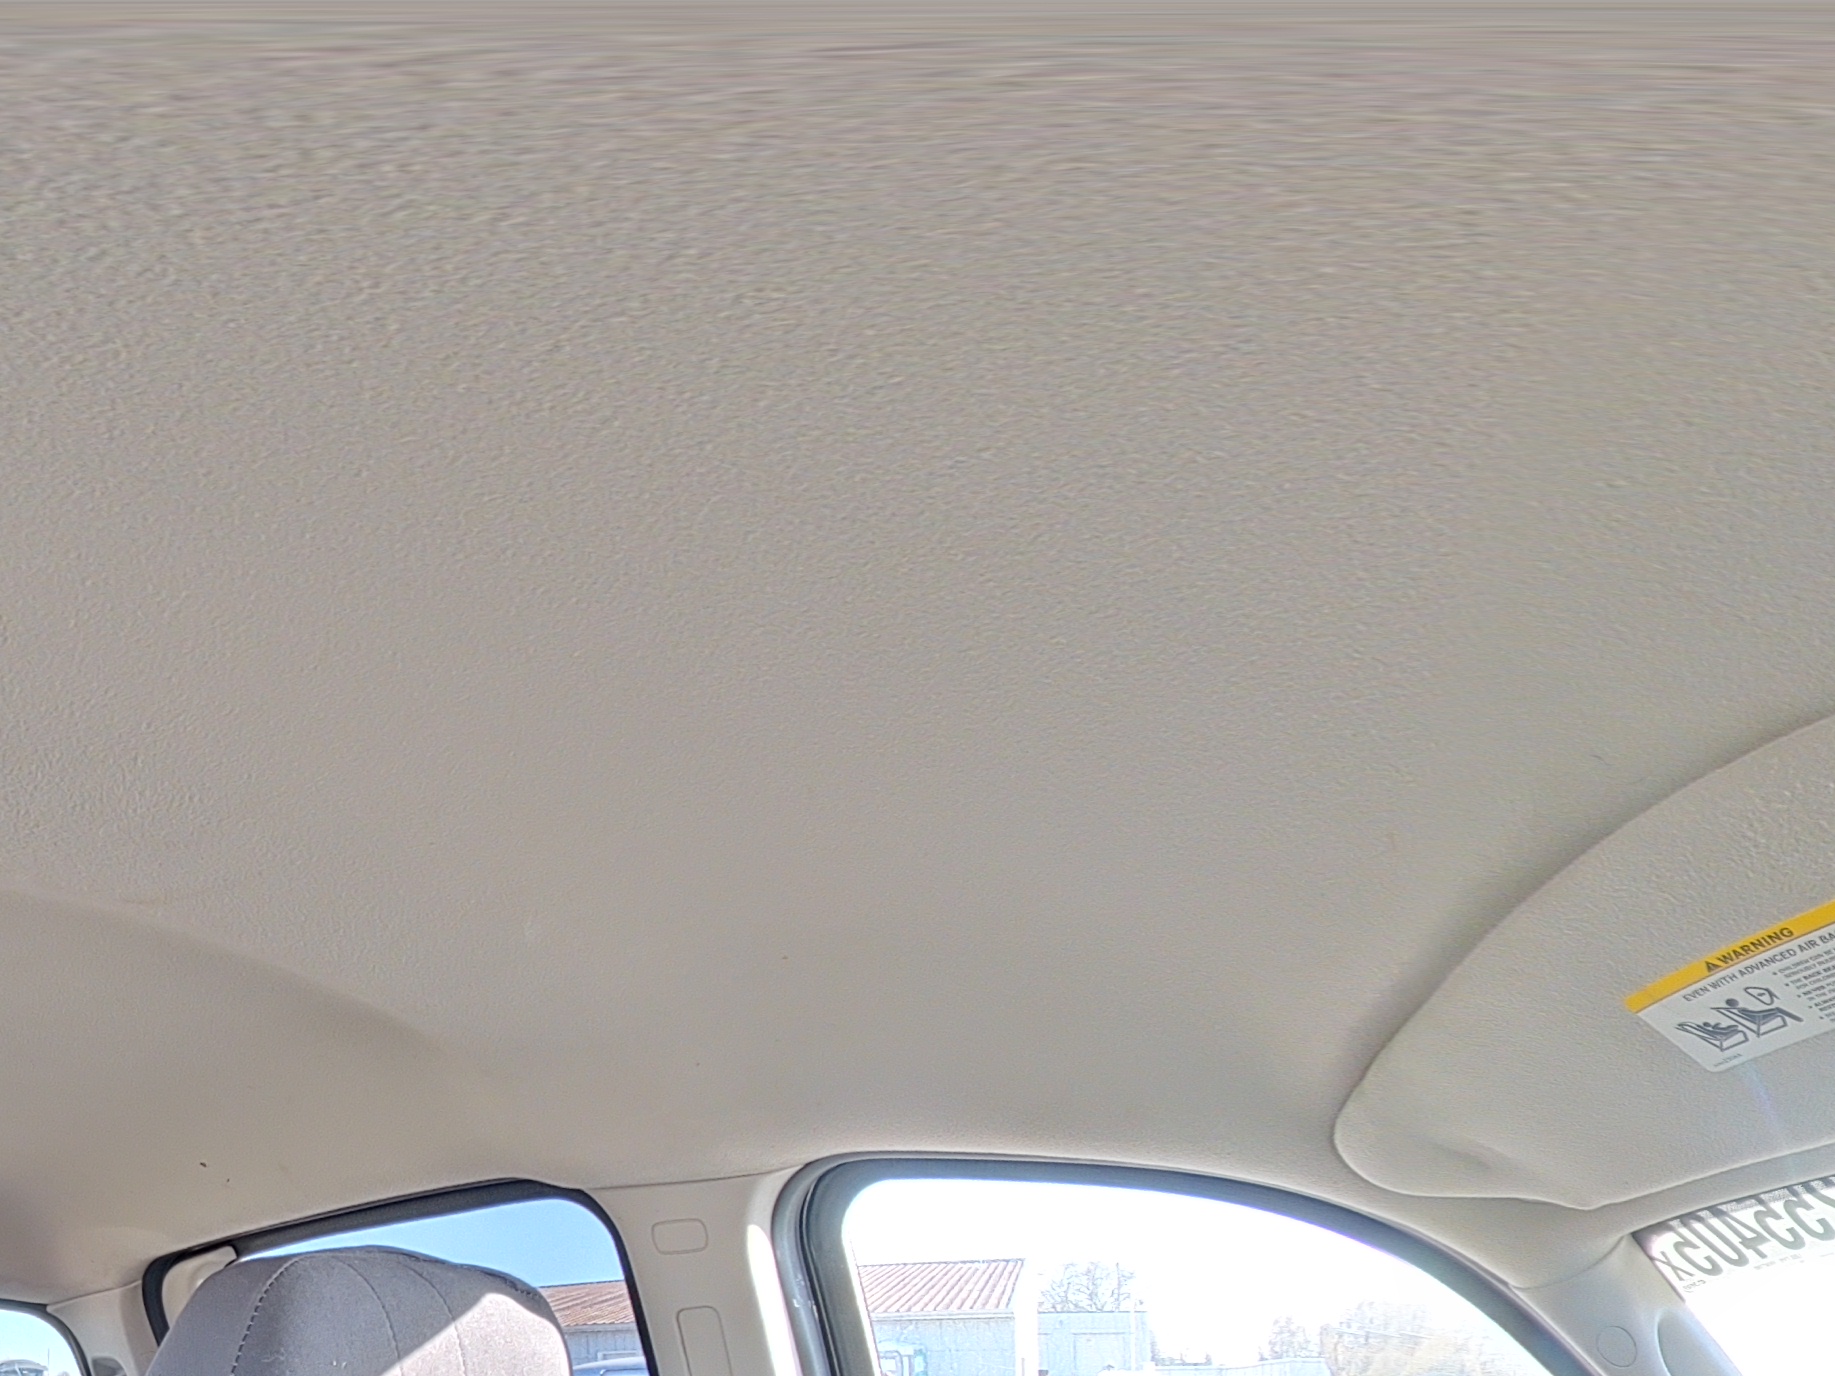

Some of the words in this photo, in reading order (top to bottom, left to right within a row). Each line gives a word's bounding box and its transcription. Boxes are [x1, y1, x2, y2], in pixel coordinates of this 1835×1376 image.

[1682, 984, 1709, 1002] EVEN
[1708, 970, 1738, 990] WITH
[1738, 946, 1796, 977] ADVANCED
[1797, 937, 1819, 953] AIR
[1718, 925, 1793, 966] WARNING
